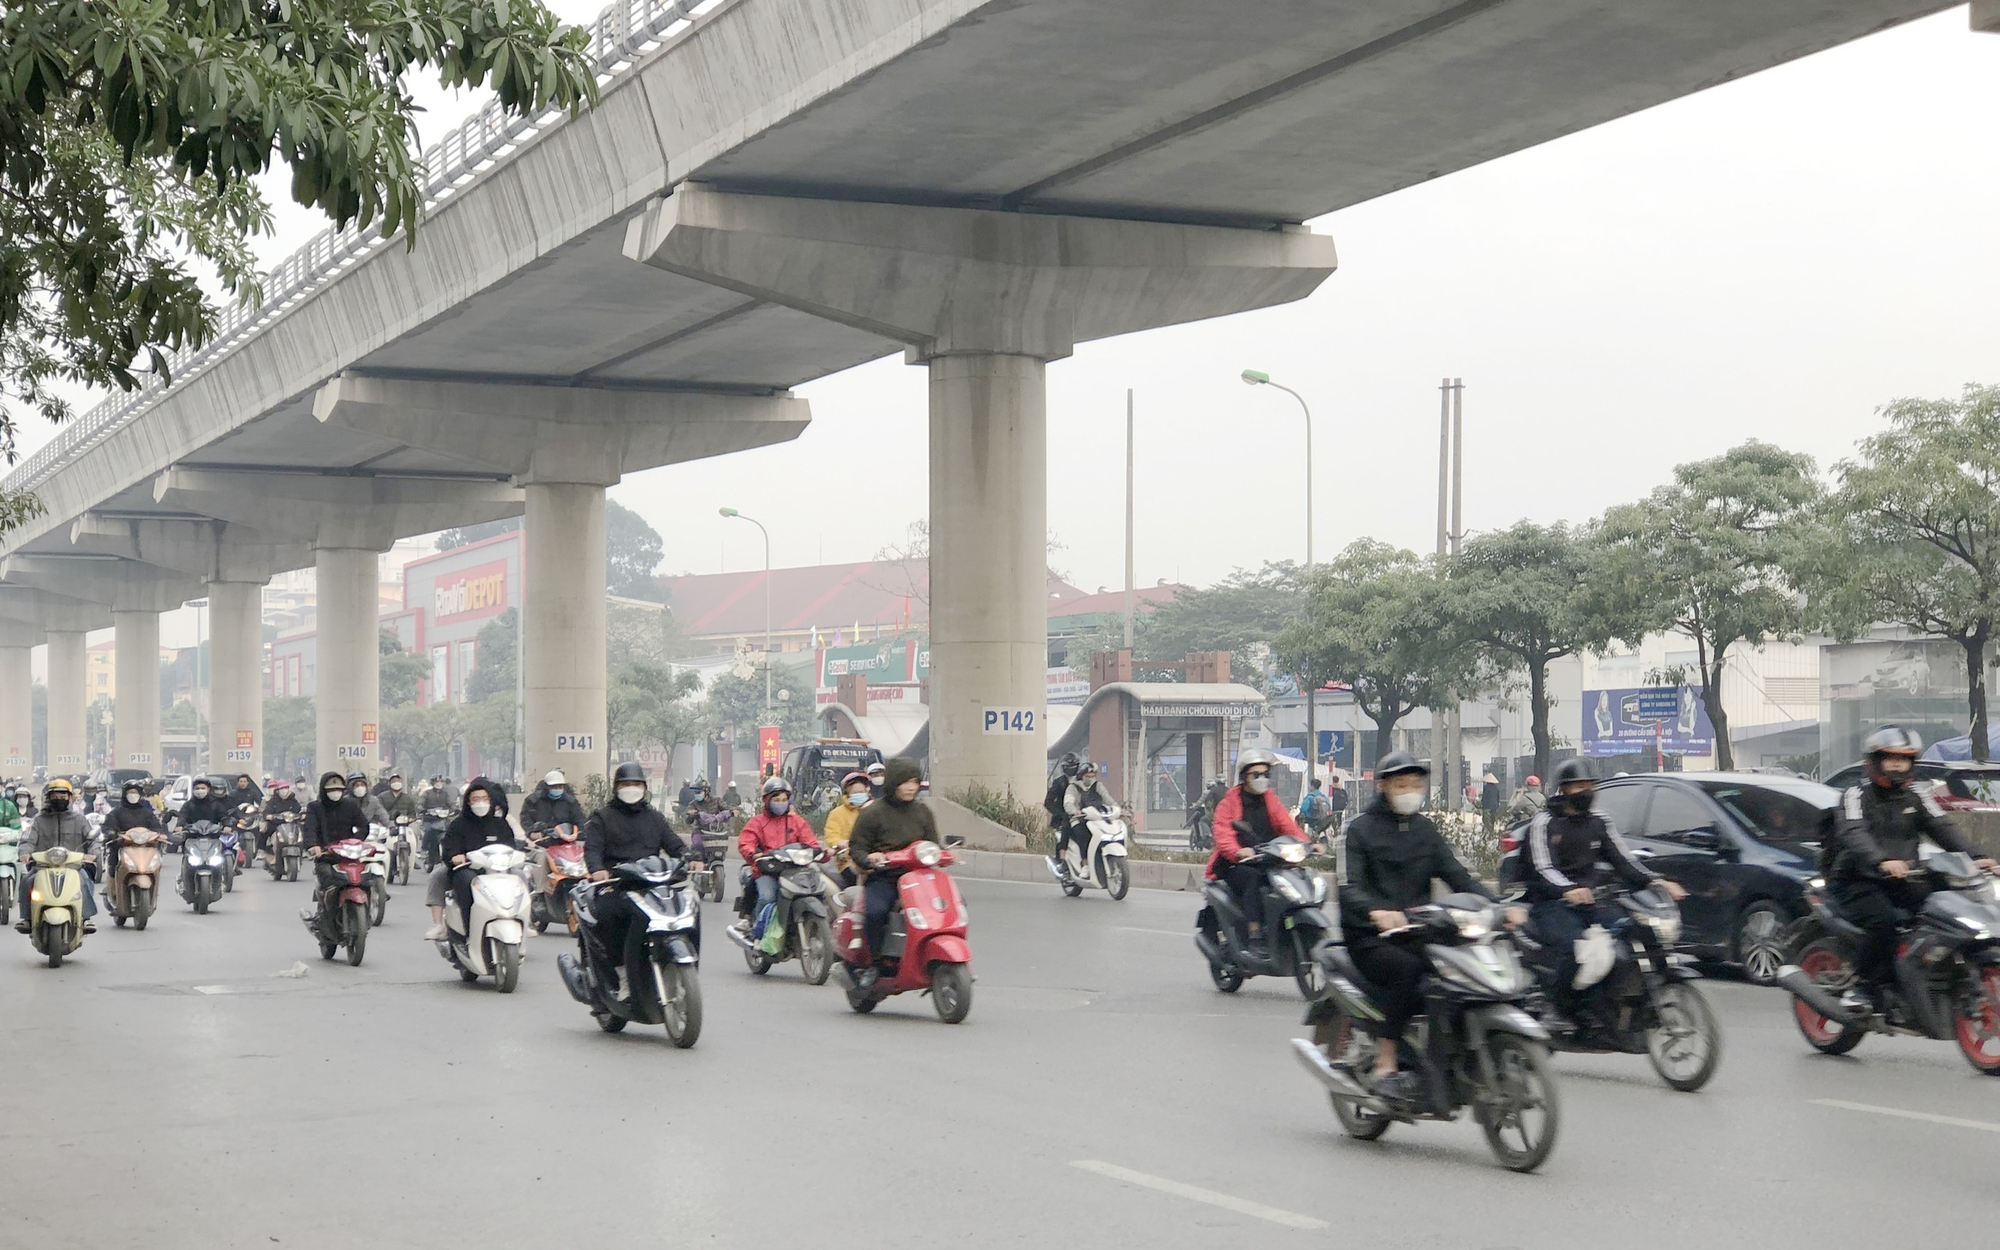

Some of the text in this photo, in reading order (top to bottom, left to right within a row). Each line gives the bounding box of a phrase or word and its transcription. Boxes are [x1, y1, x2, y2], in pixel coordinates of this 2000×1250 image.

[850, 658, 876, 671] SERVICE
[1188, 706, 1205, 715] CHO
[557, 735, 593, 750] P141
[227, 751, 251, 760] P139
[338, 746, 366, 757] P140
[130, 754, 151, 763] P138
